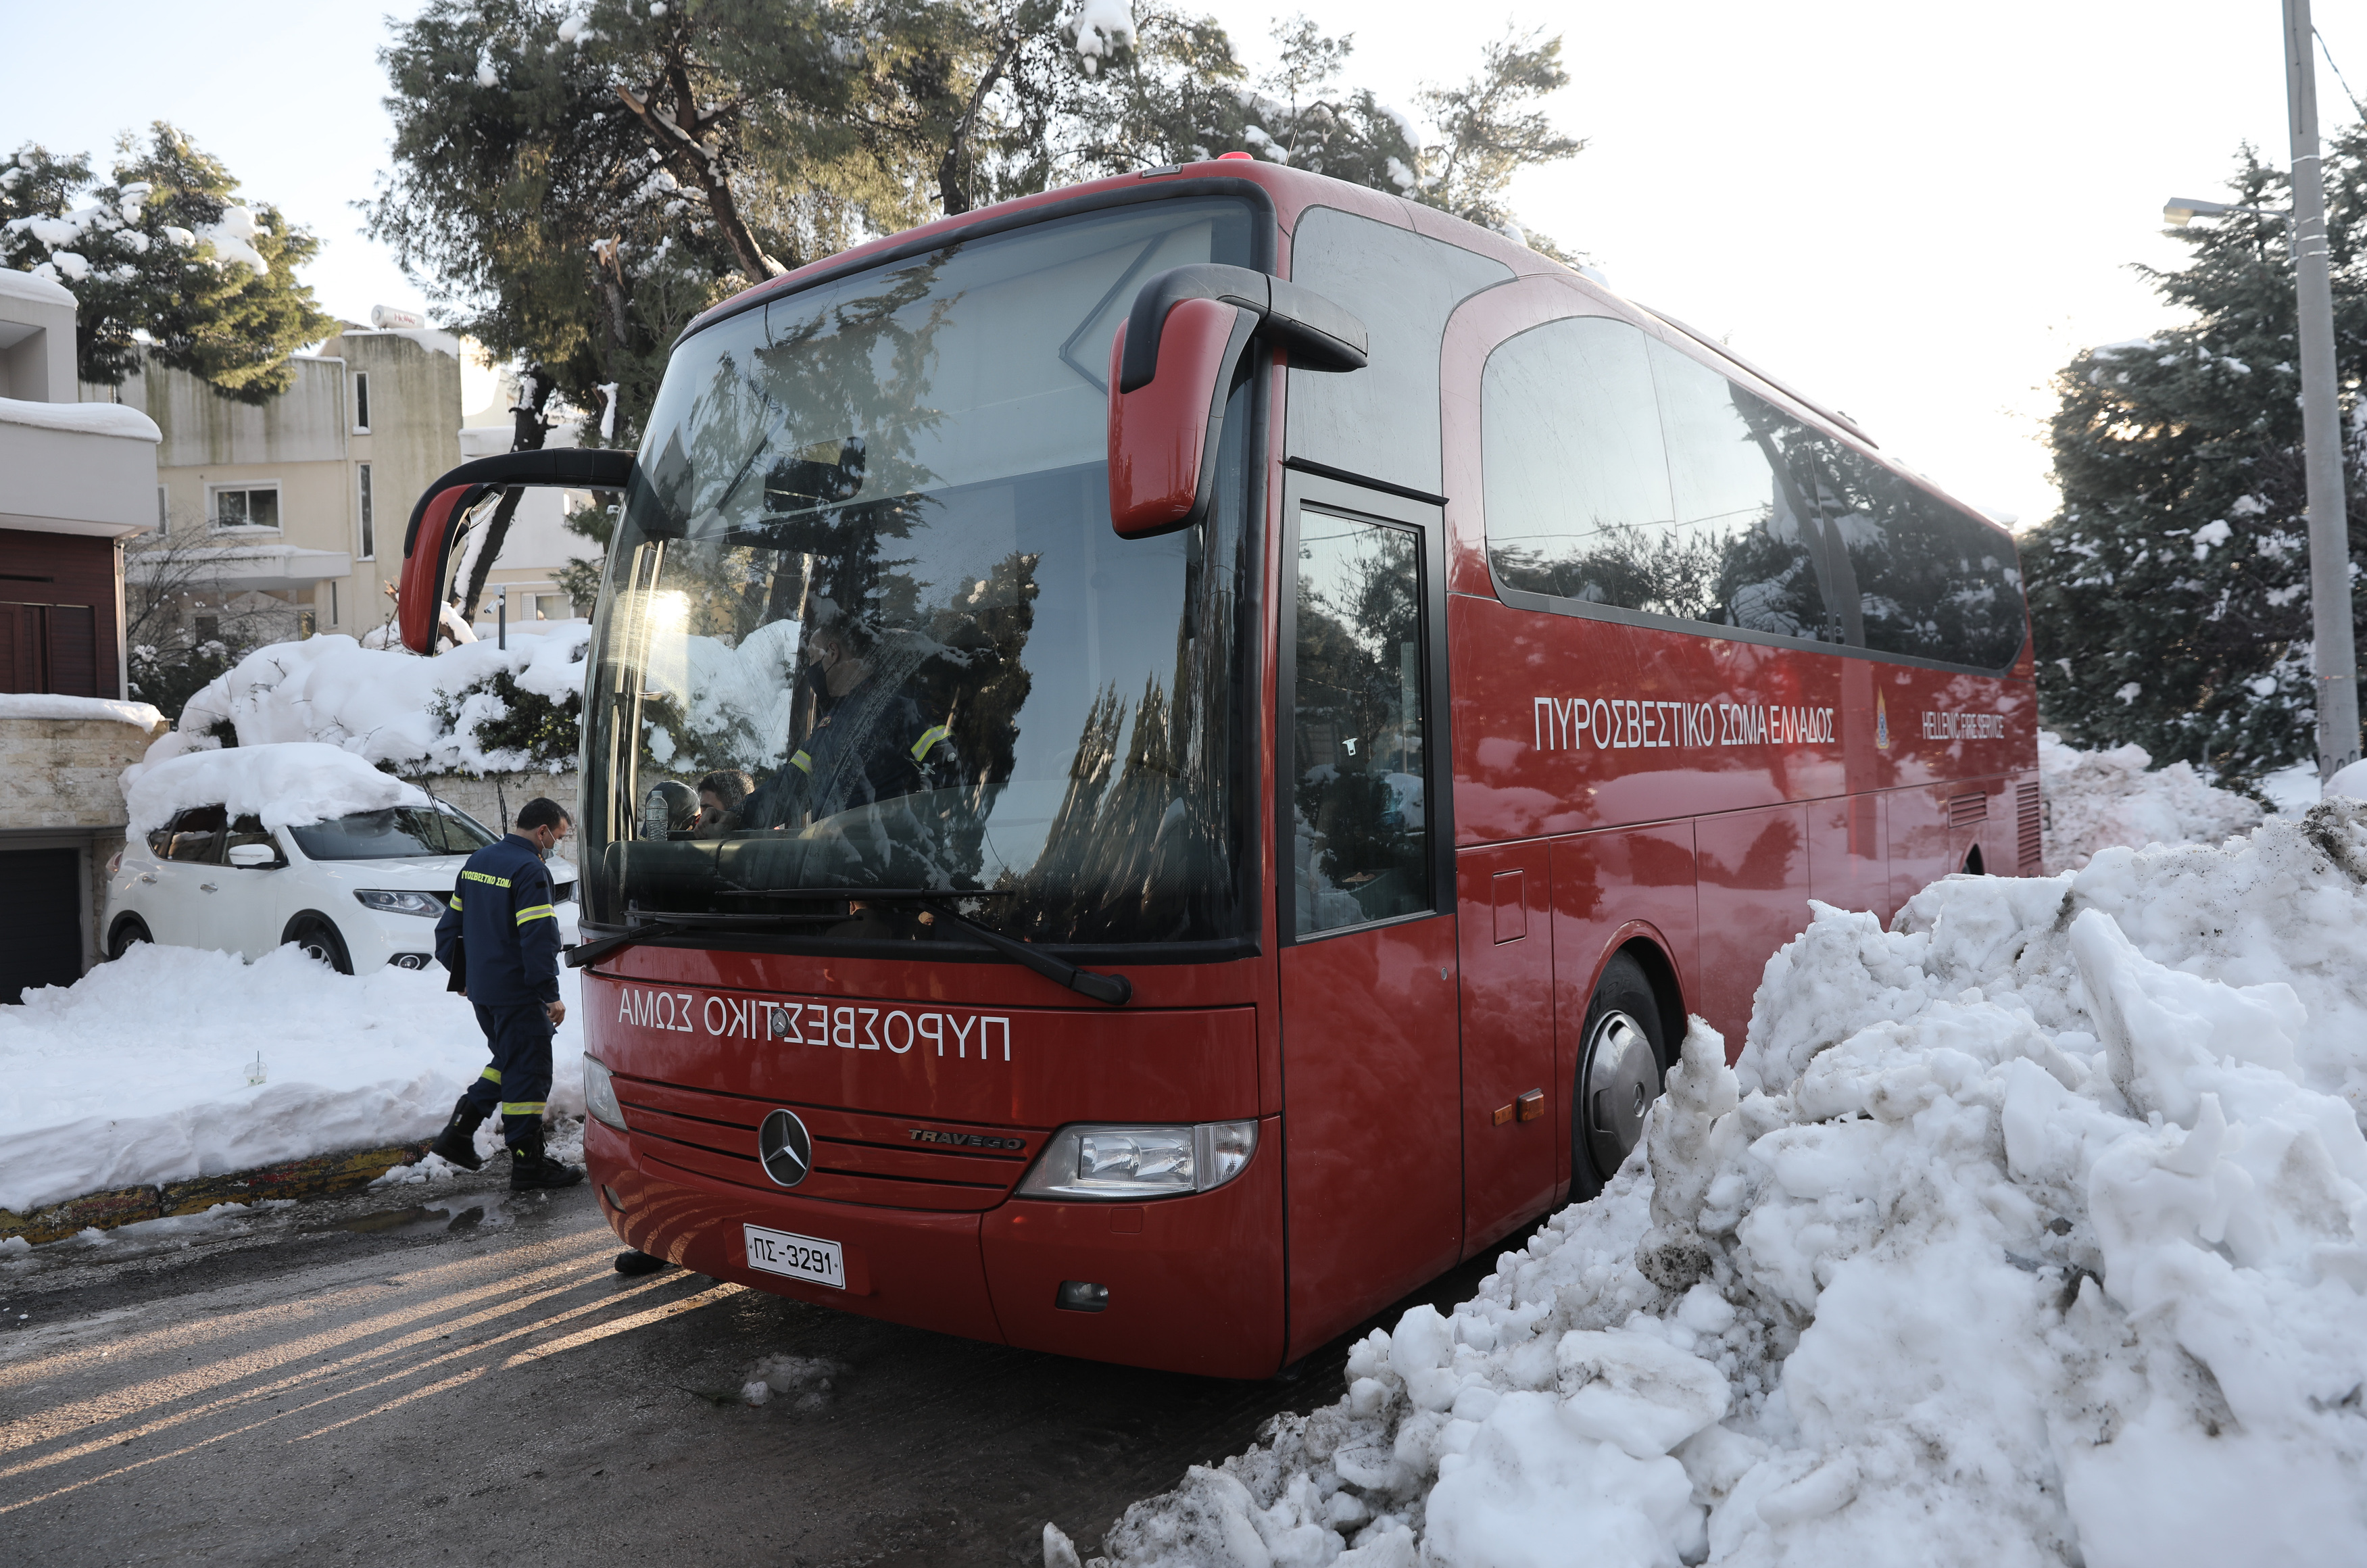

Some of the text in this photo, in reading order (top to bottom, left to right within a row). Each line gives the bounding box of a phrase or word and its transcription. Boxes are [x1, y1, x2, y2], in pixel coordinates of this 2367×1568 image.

[1534, 697, 1835, 750] ΠΥΡΟΣΒΕΣΤΙΚΟ ΣΩΜΑ ΕΛΛΑΔΟΣ
[1922, 711, 2005, 739] HELLENIC FIRE SERVICE
[908, 1129, 1027, 1150] TRAVEGO
[754, 1237, 832, 1275] ΠΣ-3291
